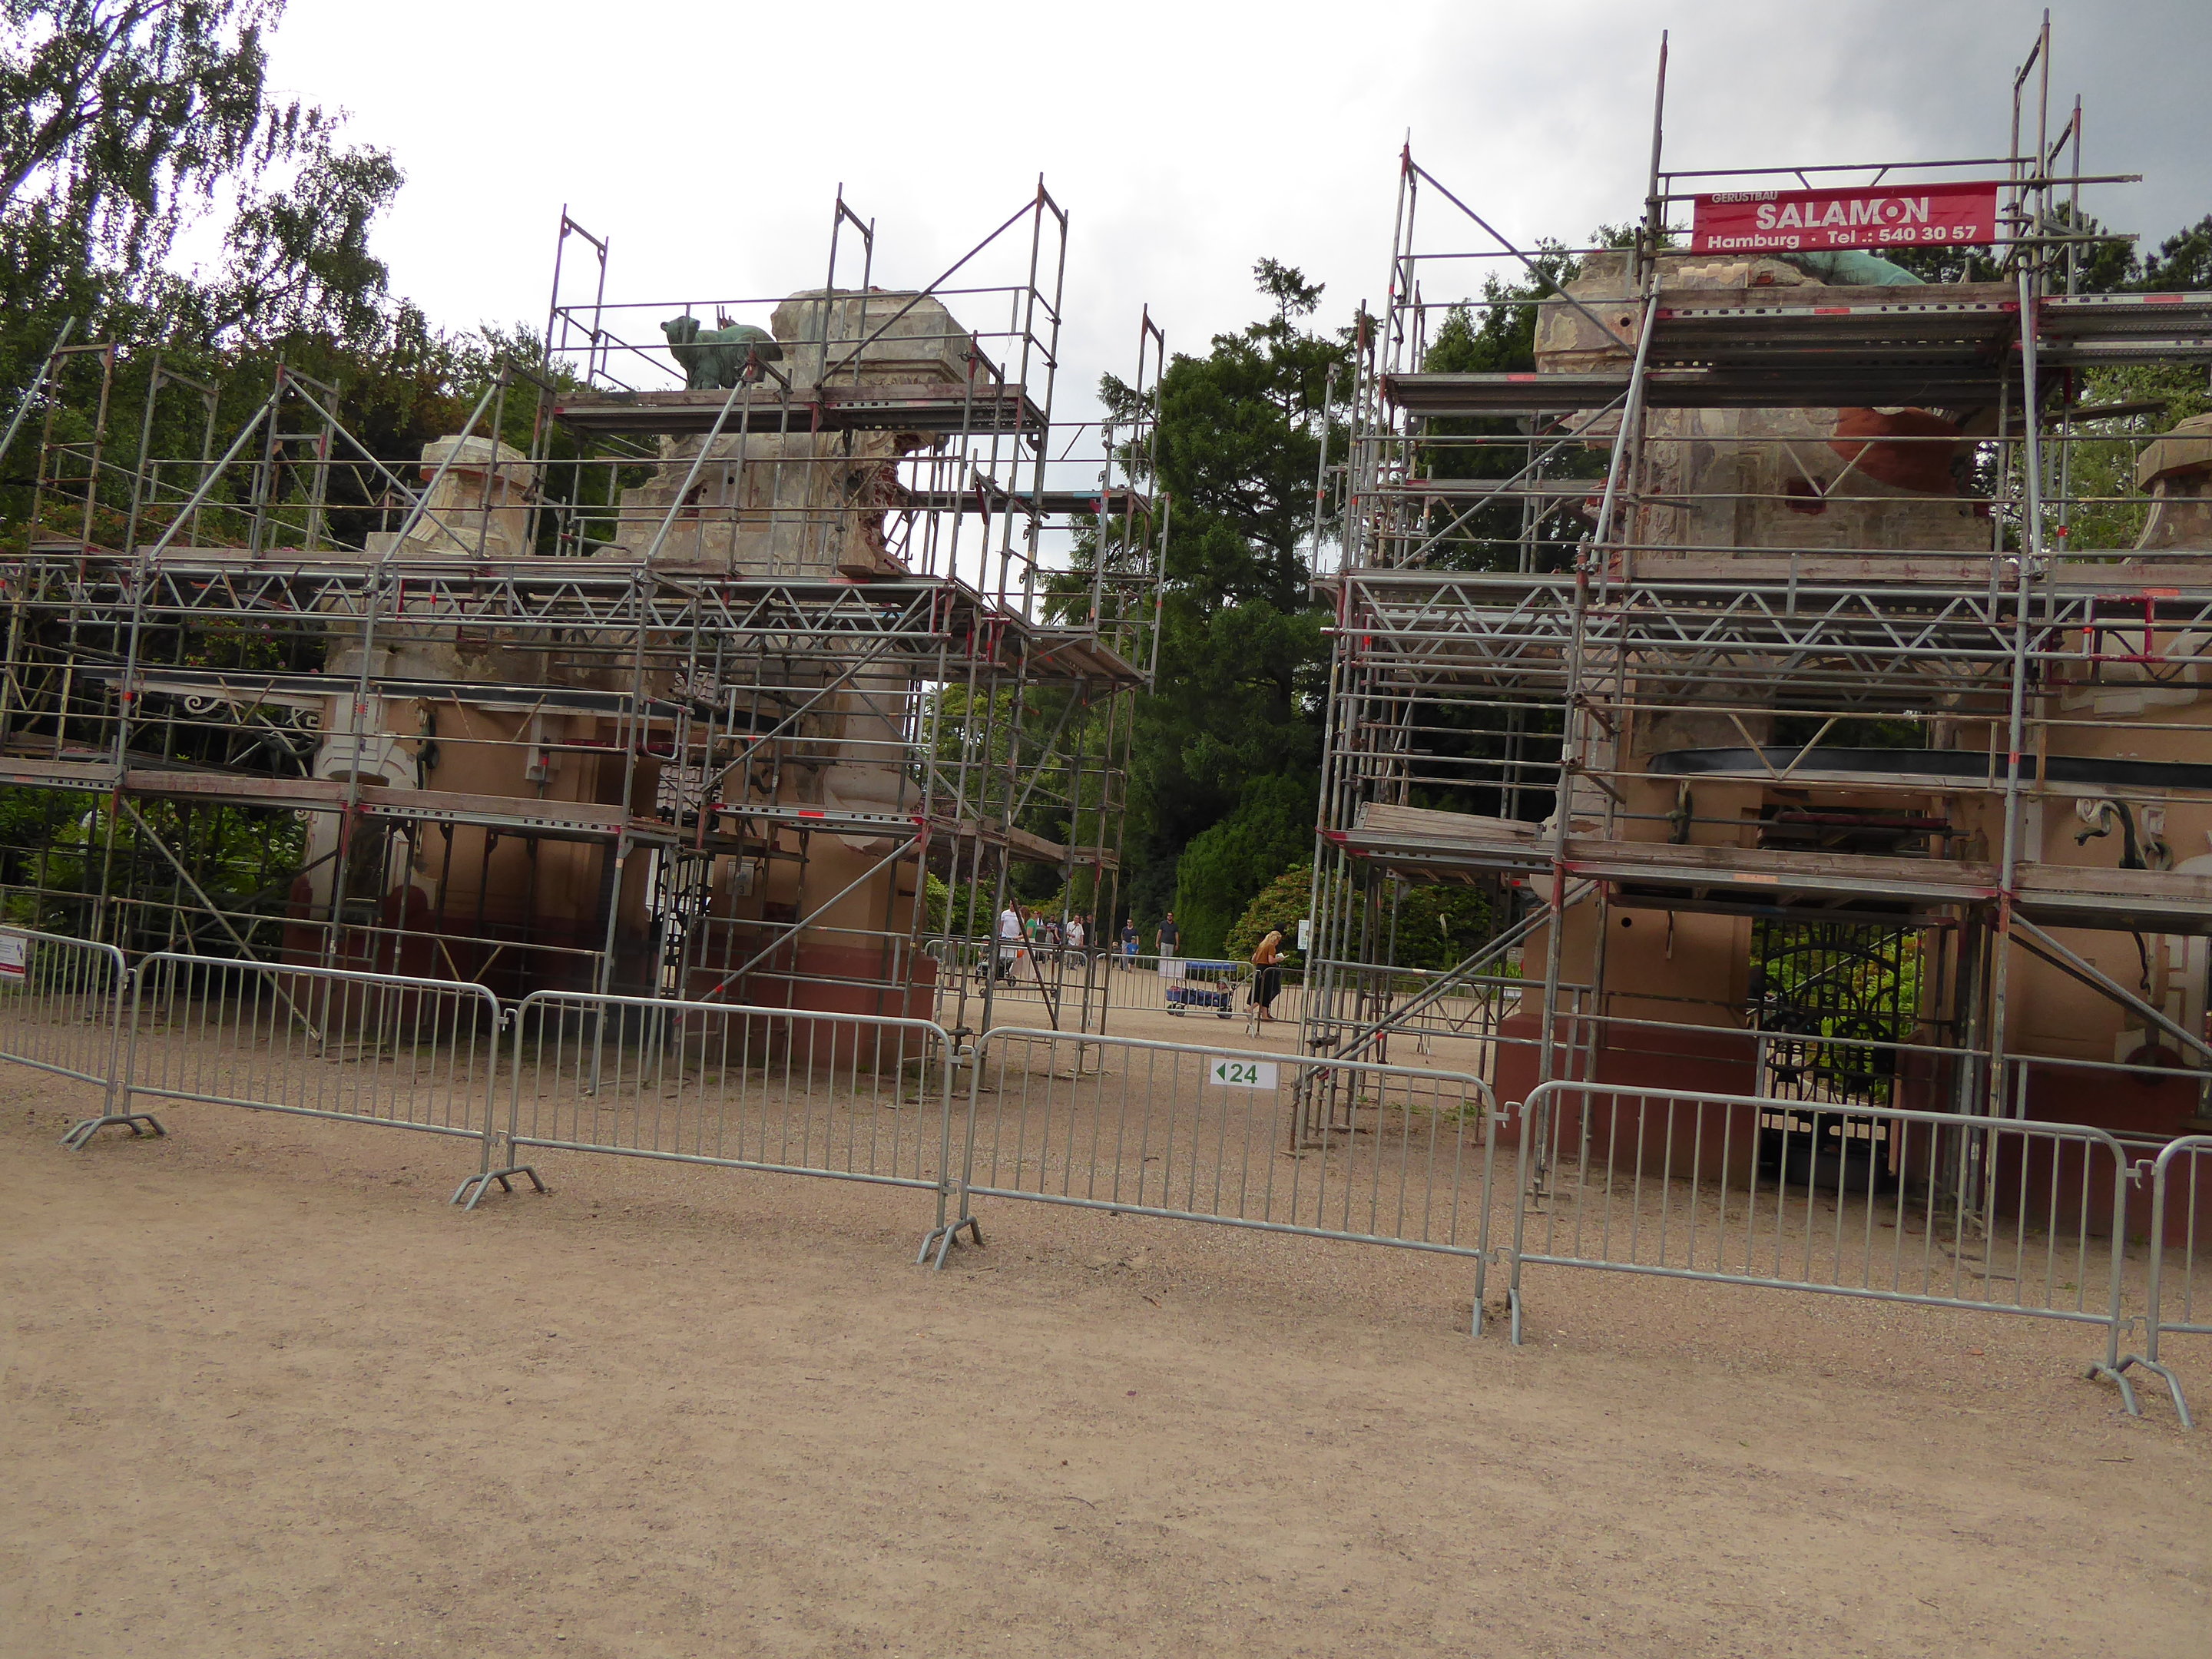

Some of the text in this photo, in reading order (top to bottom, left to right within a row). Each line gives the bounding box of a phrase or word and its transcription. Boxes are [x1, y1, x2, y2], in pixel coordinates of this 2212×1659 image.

[1756, 197, 1929, 230] SALAMON
[1707, 233, 1800, 250] Hamburg
[1879, 227, 1916, 243] 540
[1921, 226, 1947, 240] 30
[1952, 224, 1977, 240] 57
[1230, 1063, 1258, 1084] 24
